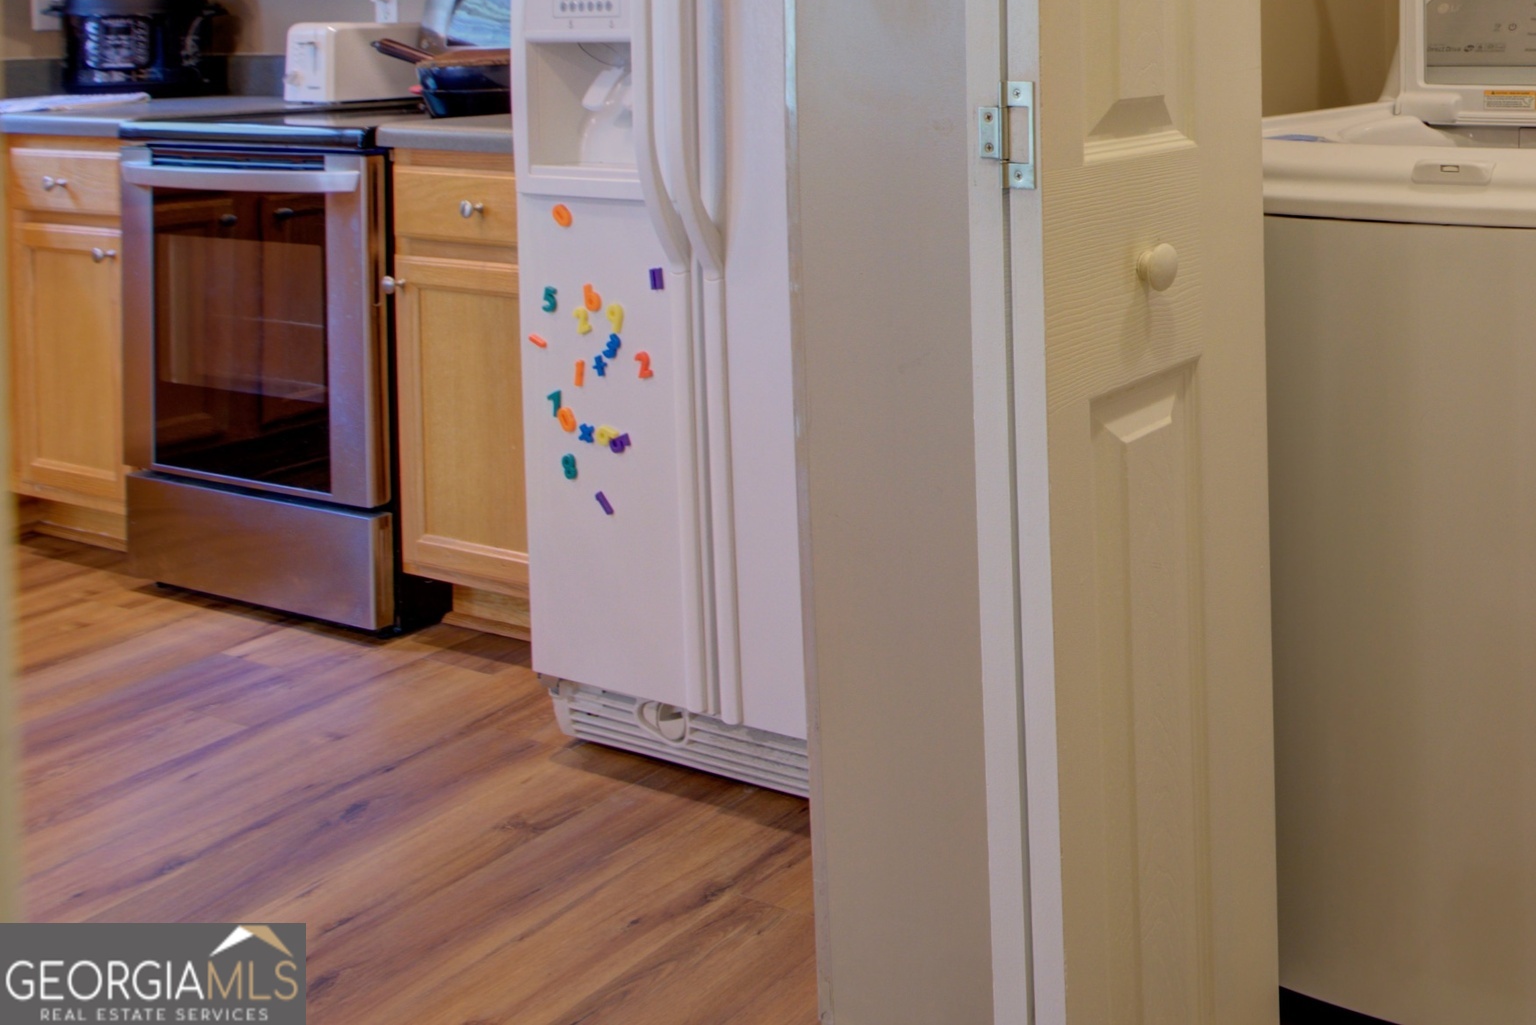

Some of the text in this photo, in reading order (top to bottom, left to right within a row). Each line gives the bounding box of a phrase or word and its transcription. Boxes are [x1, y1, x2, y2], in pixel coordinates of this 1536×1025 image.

[542, 286, 558, 312] 5
[634, 352, 653, 378] 2
[562, 454, 578, 480] 8
